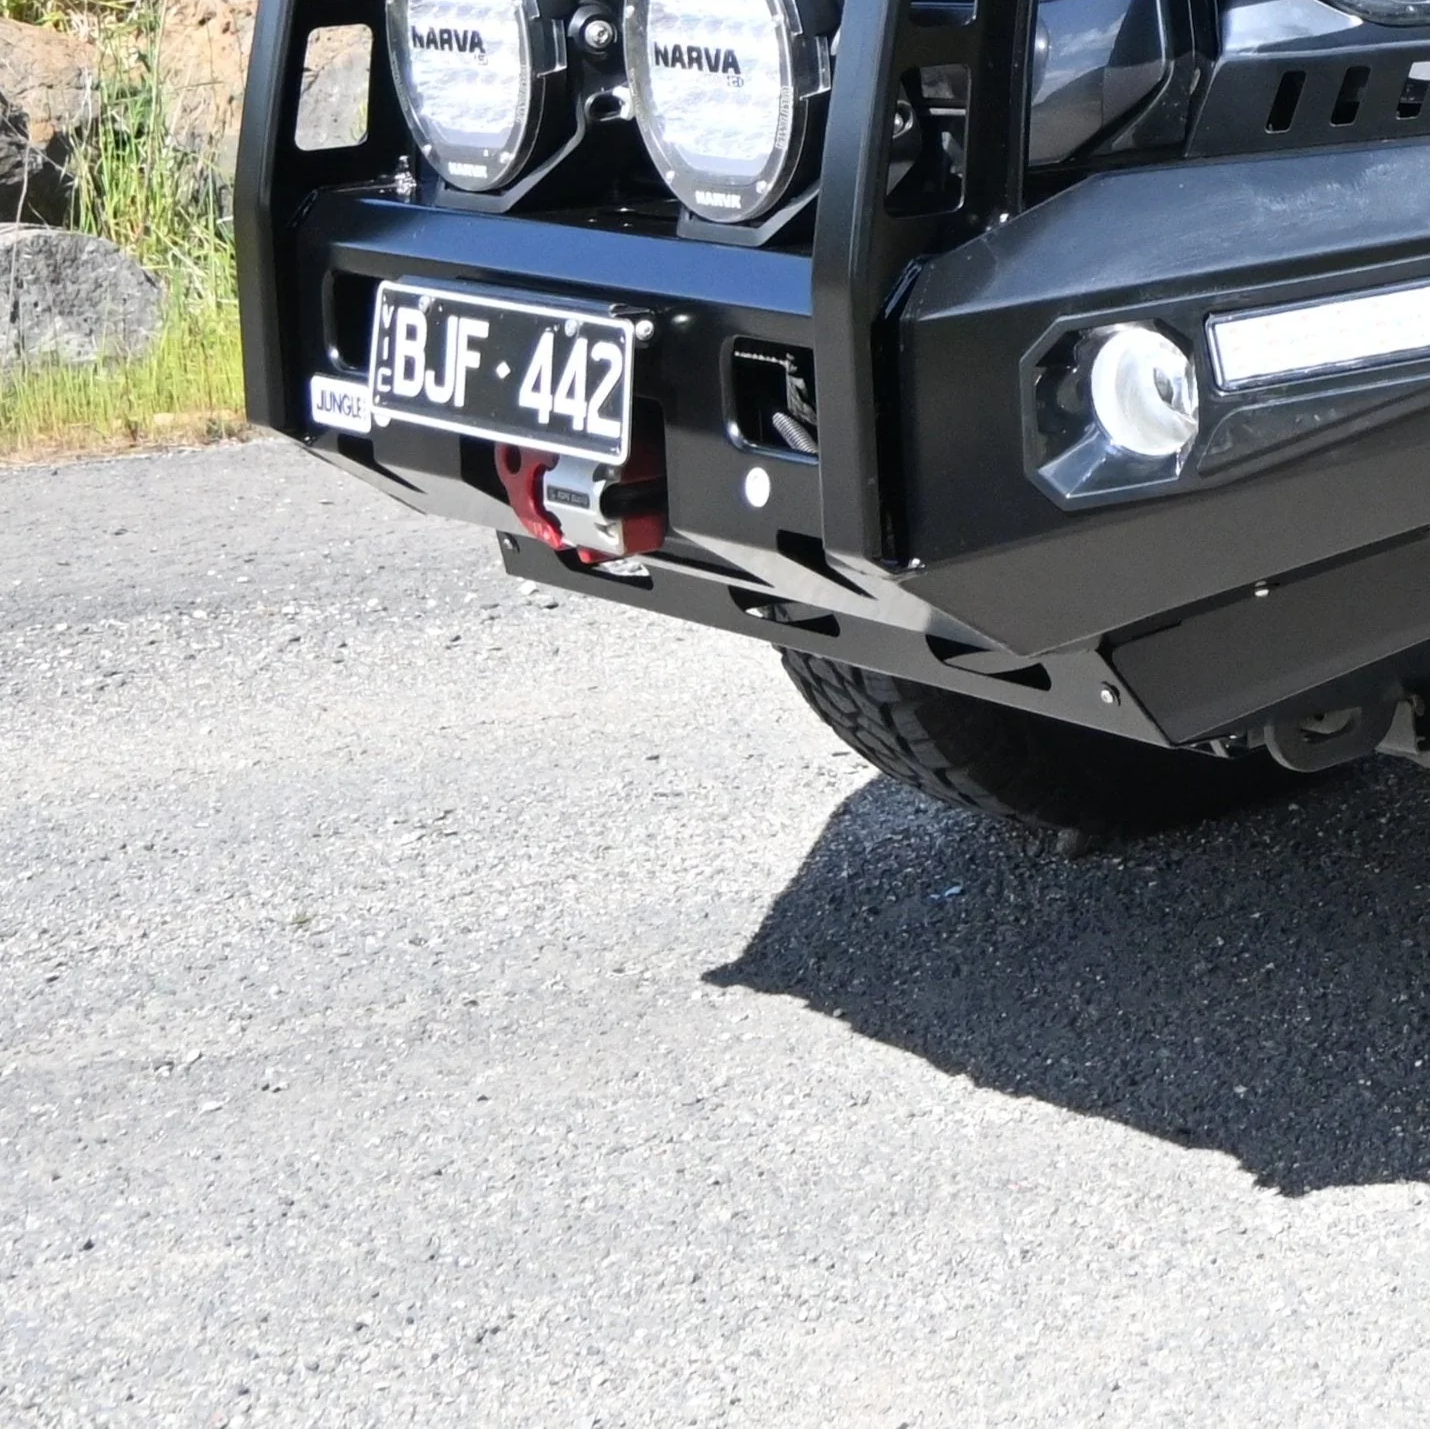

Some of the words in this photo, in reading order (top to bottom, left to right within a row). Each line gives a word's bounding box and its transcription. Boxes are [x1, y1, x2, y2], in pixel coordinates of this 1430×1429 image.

[411, 25, 486, 54] NARVA
[653, 41, 742, 75] NARVA
[376, 302, 395, 393] VIC
[392, 306, 490, 408] BJF
[518, 328, 623, 439] 442
[316, 389, 362, 419] JUNGLE
